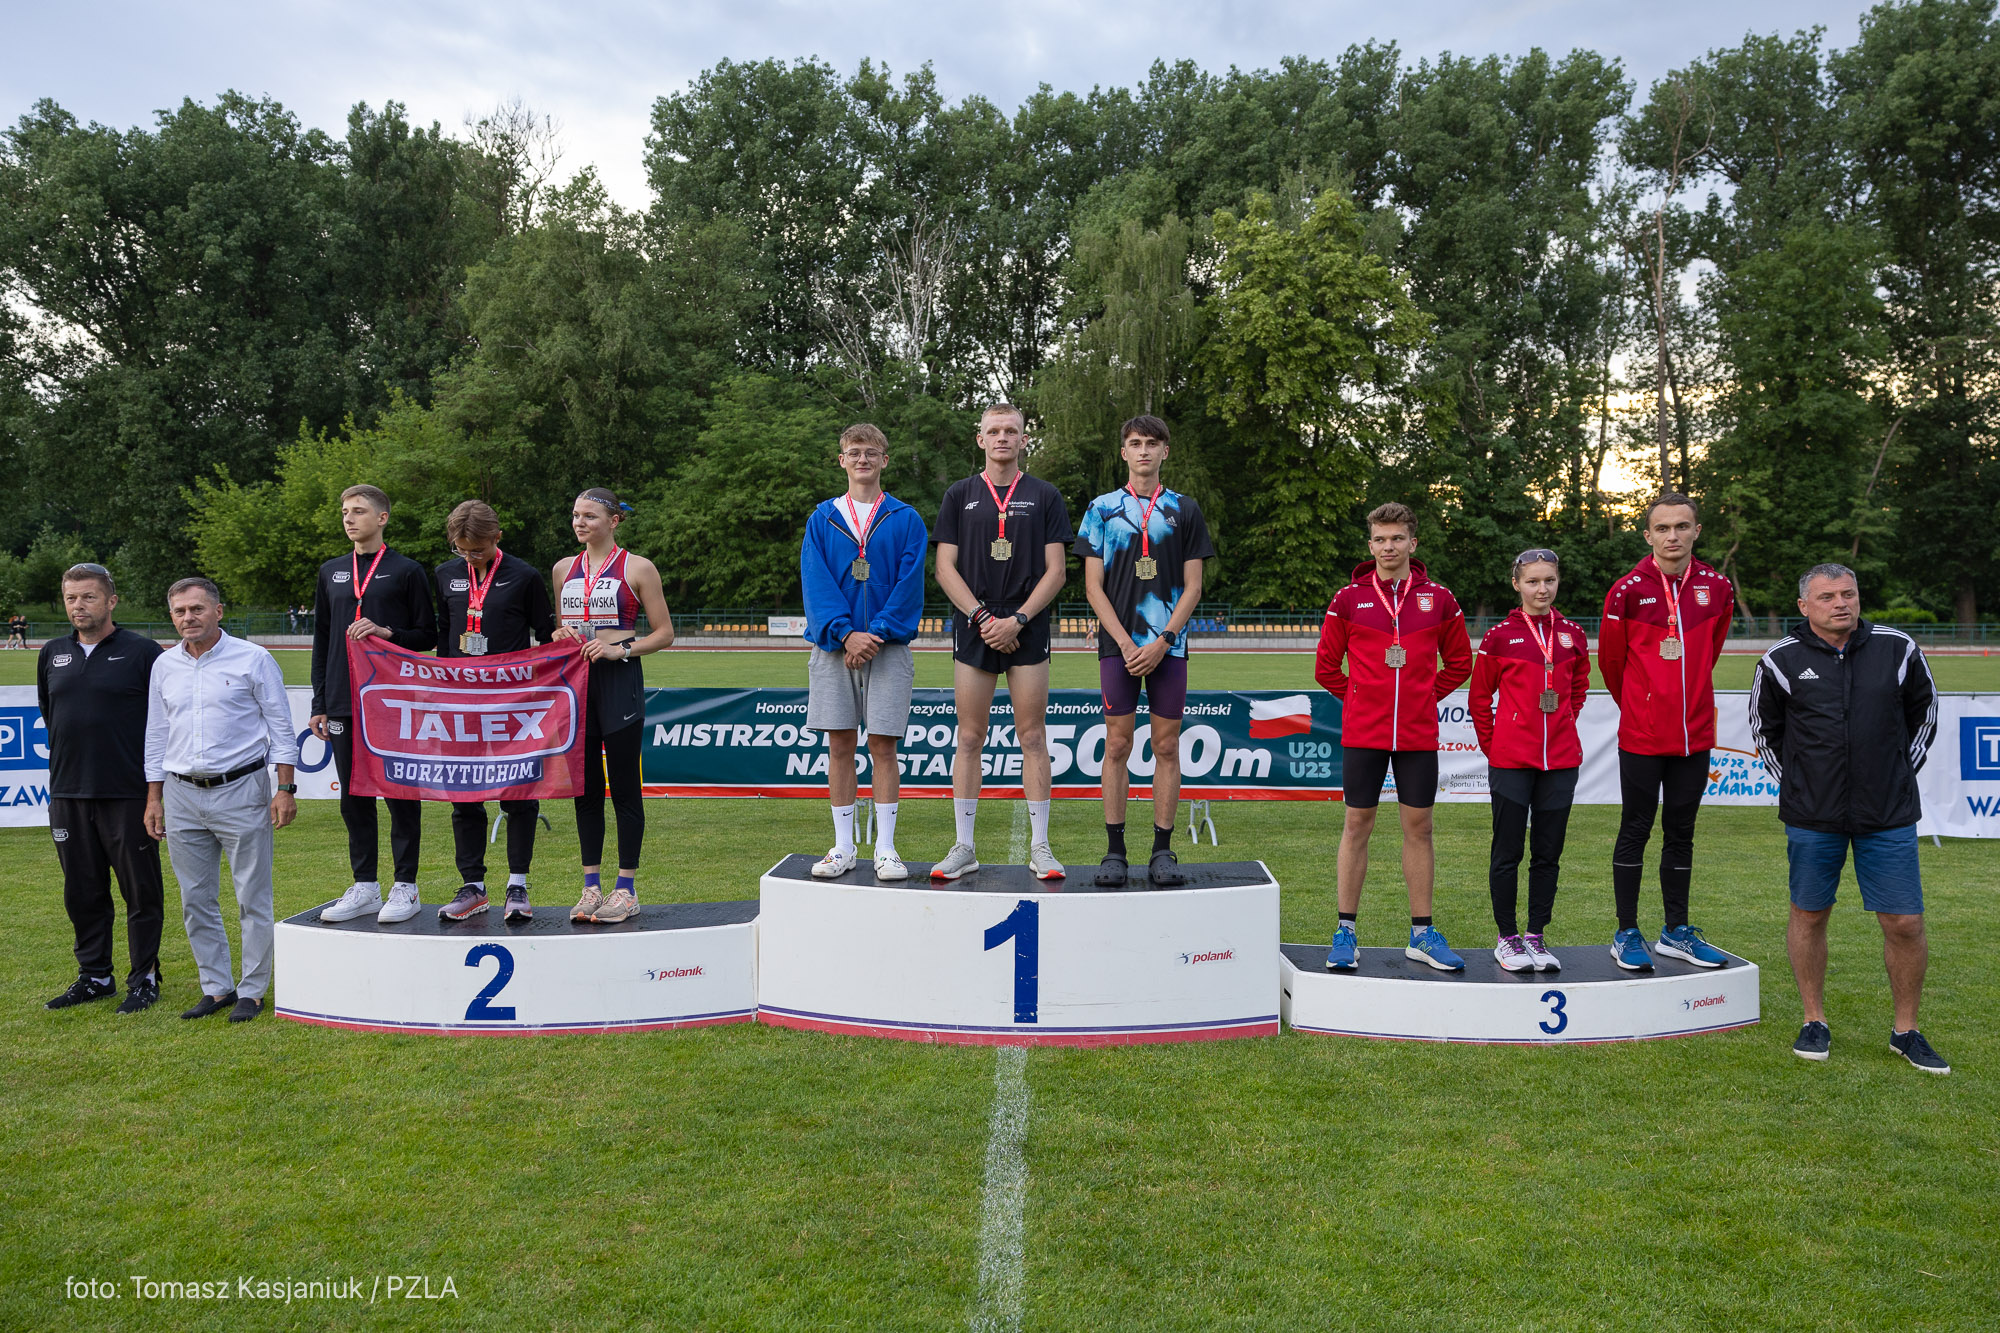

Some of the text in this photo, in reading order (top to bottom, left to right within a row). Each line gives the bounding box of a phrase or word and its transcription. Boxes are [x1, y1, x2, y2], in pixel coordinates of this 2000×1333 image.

[1640, 597, 1657, 605] JAKO
[400, 661, 533, 683] BORYSŁAW
[381, 698, 556, 742] TALEX
[755, 703, 1232, 717] Honoro rezyde asta chanów osiński
[1437, 706, 1474, 723] MOS
[0, 725, 15, 753] P
[653, 724, 868, 747] MISTRZOS
[1045, 724, 1272, 778] 5000m
[1288, 742, 1332, 759] U20
[1982, 735, 2000, 762] T
[1289, 762, 1332, 779] U23
[1710, 753, 1745, 768] wórz
[392, 761, 534, 784] BORZYTUCHOM
[1730, 769, 1749, 781] na
[0, 785, 50, 807] ZAW
[1450, 781, 1471, 789] Sportu
[1703, 775, 1780, 797] chanów
[984, 900, 1039, 1023] 1
[1192, 949, 1233, 964] polanik
[464, 943, 516, 1021] 2
[659, 965, 703, 981] polanik
[1539, 990, 1568, 1035] 3
[1692, 994, 1725, 1010] polanik
